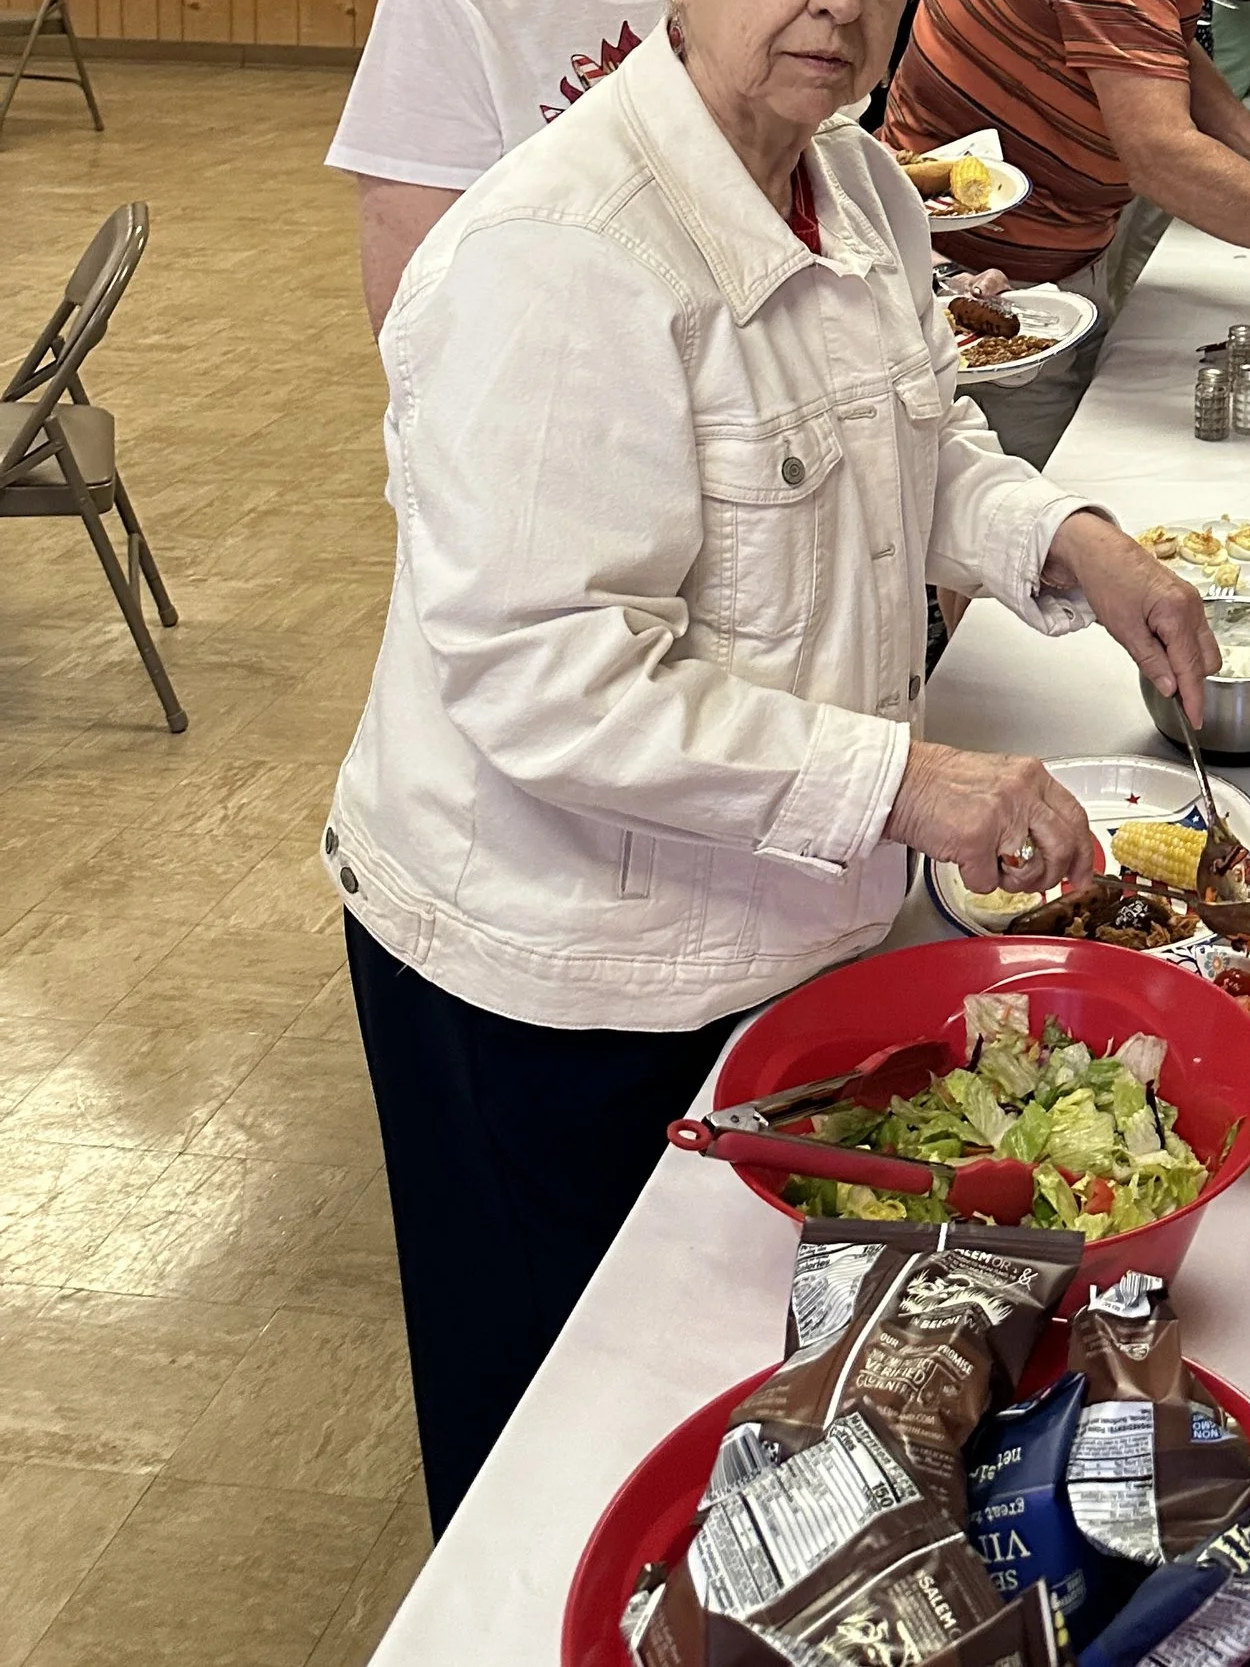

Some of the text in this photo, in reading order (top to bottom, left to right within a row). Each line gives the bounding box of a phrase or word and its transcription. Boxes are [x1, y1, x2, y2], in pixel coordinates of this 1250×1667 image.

[919, 1314, 963, 1329] BELOIT
[879, 1332, 900, 1347] OUR
[865, 1357, 926, 1385] VERIFIED
[937, 1344, 974, 1375] PROMISE
[1193, 1429, 1220, 1439] NON
[997, 1446, 1022, 1469] net
[871, 1480, 895, 1509] 150
[985, 1497, 1025, 1522] great
[918, 1575, 957, 1630] SALEM
